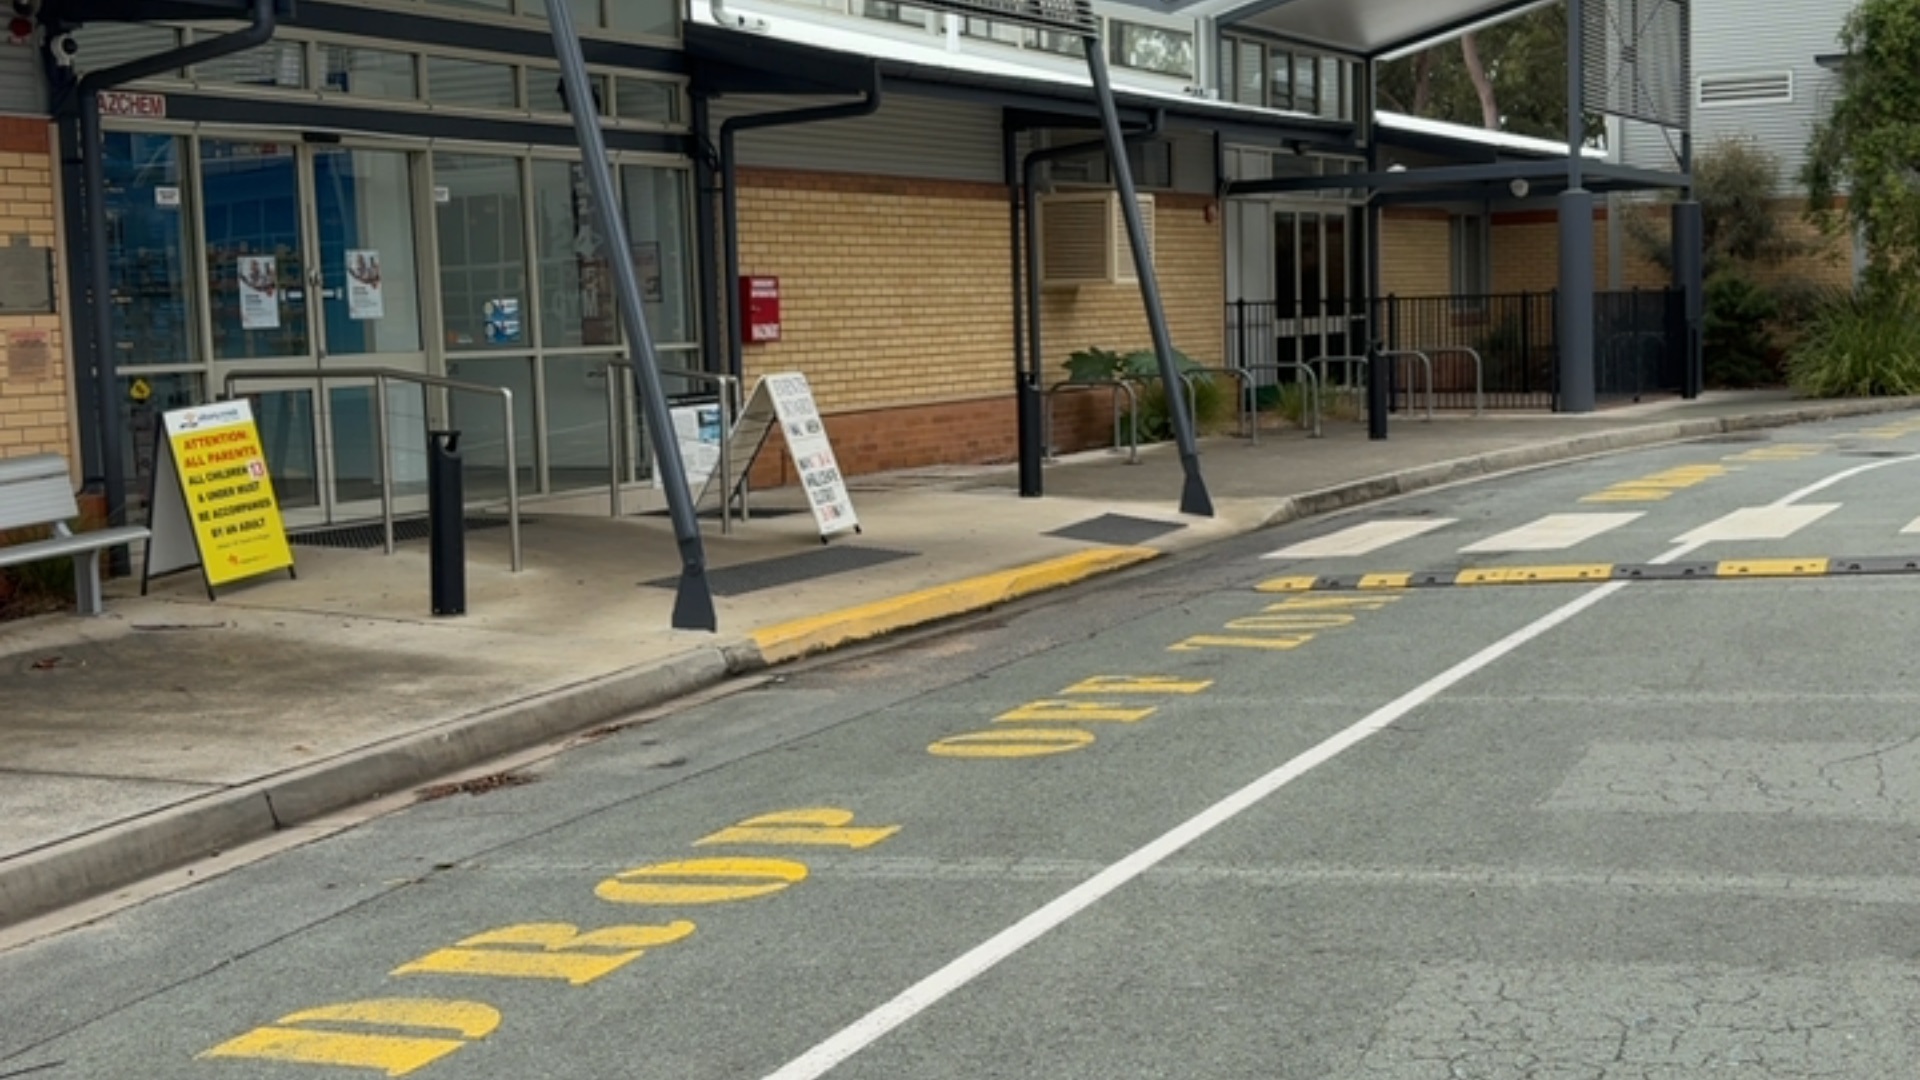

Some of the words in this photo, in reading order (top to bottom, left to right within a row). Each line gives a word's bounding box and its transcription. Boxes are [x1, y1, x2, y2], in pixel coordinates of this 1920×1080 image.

[184, 456, 206, 469] ALL
[207, 445, 258, 464] PARENTS
[204, 465, 248, 482] CHILDREN
[193, 807, 903, 1077] DROP
[927, 674, 1216, 758] OFF
